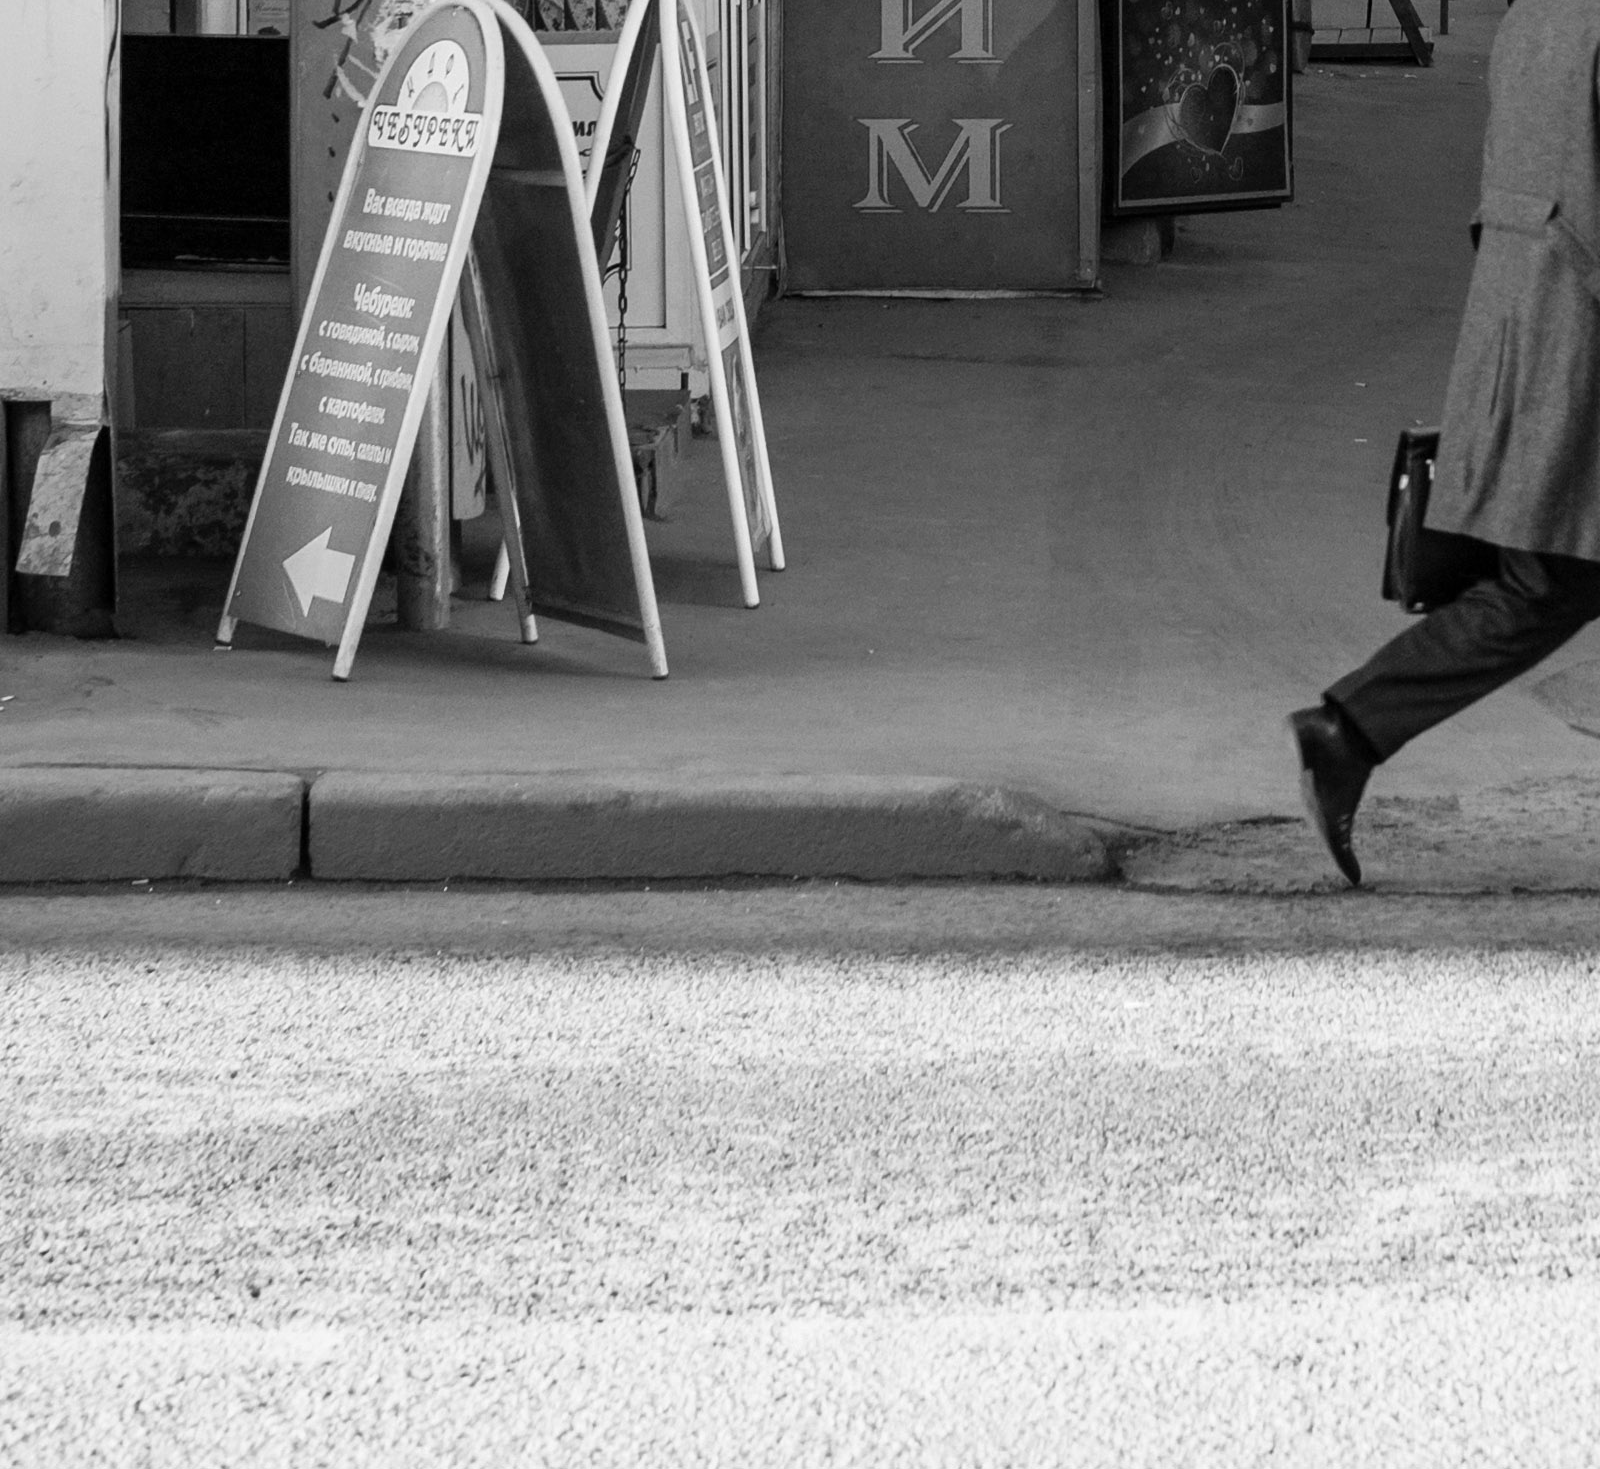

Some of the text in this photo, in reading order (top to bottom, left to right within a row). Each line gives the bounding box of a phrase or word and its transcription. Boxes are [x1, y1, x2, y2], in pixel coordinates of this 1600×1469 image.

[373, 111, 479, 152] ЧЕБУРЕКИ
[363, 188, 451, 225] Вас всегда ждут
[343, 230, 393, 255] вкусные
[392, 237, 405, 256] и
[319, 320, 328, 336] с
[300, 354, 310, 371] с
[319, 396, 328, 413] с
[288, 422, 308, 448] Так
[308, 432, 327, 452] же
